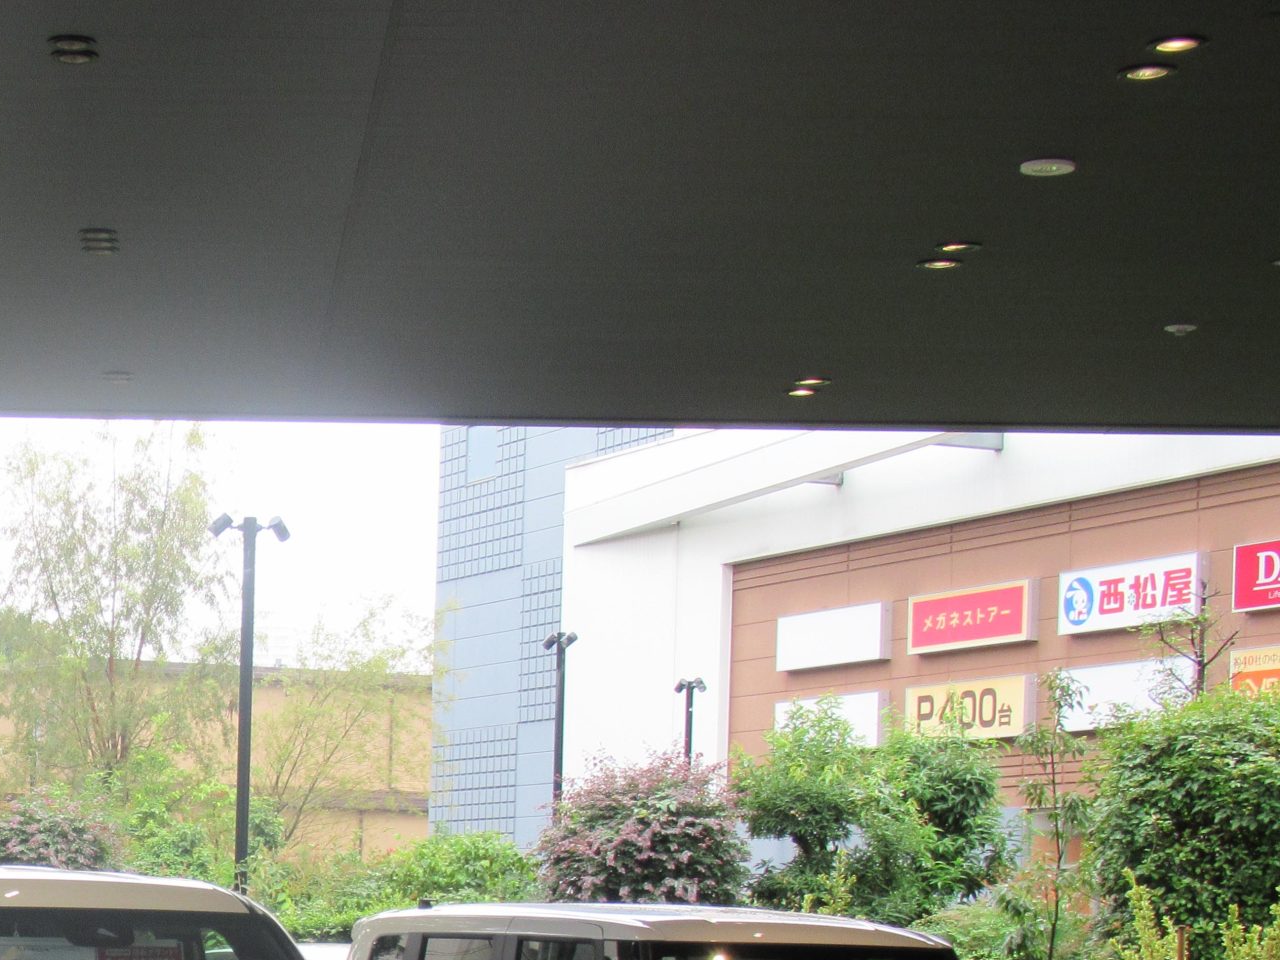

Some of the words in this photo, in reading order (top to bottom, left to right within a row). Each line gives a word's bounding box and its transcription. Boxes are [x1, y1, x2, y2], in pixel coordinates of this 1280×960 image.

[1098, 567, 1192, 615] 西松屋
[923, 606, 1012, 632] メガネストアー
